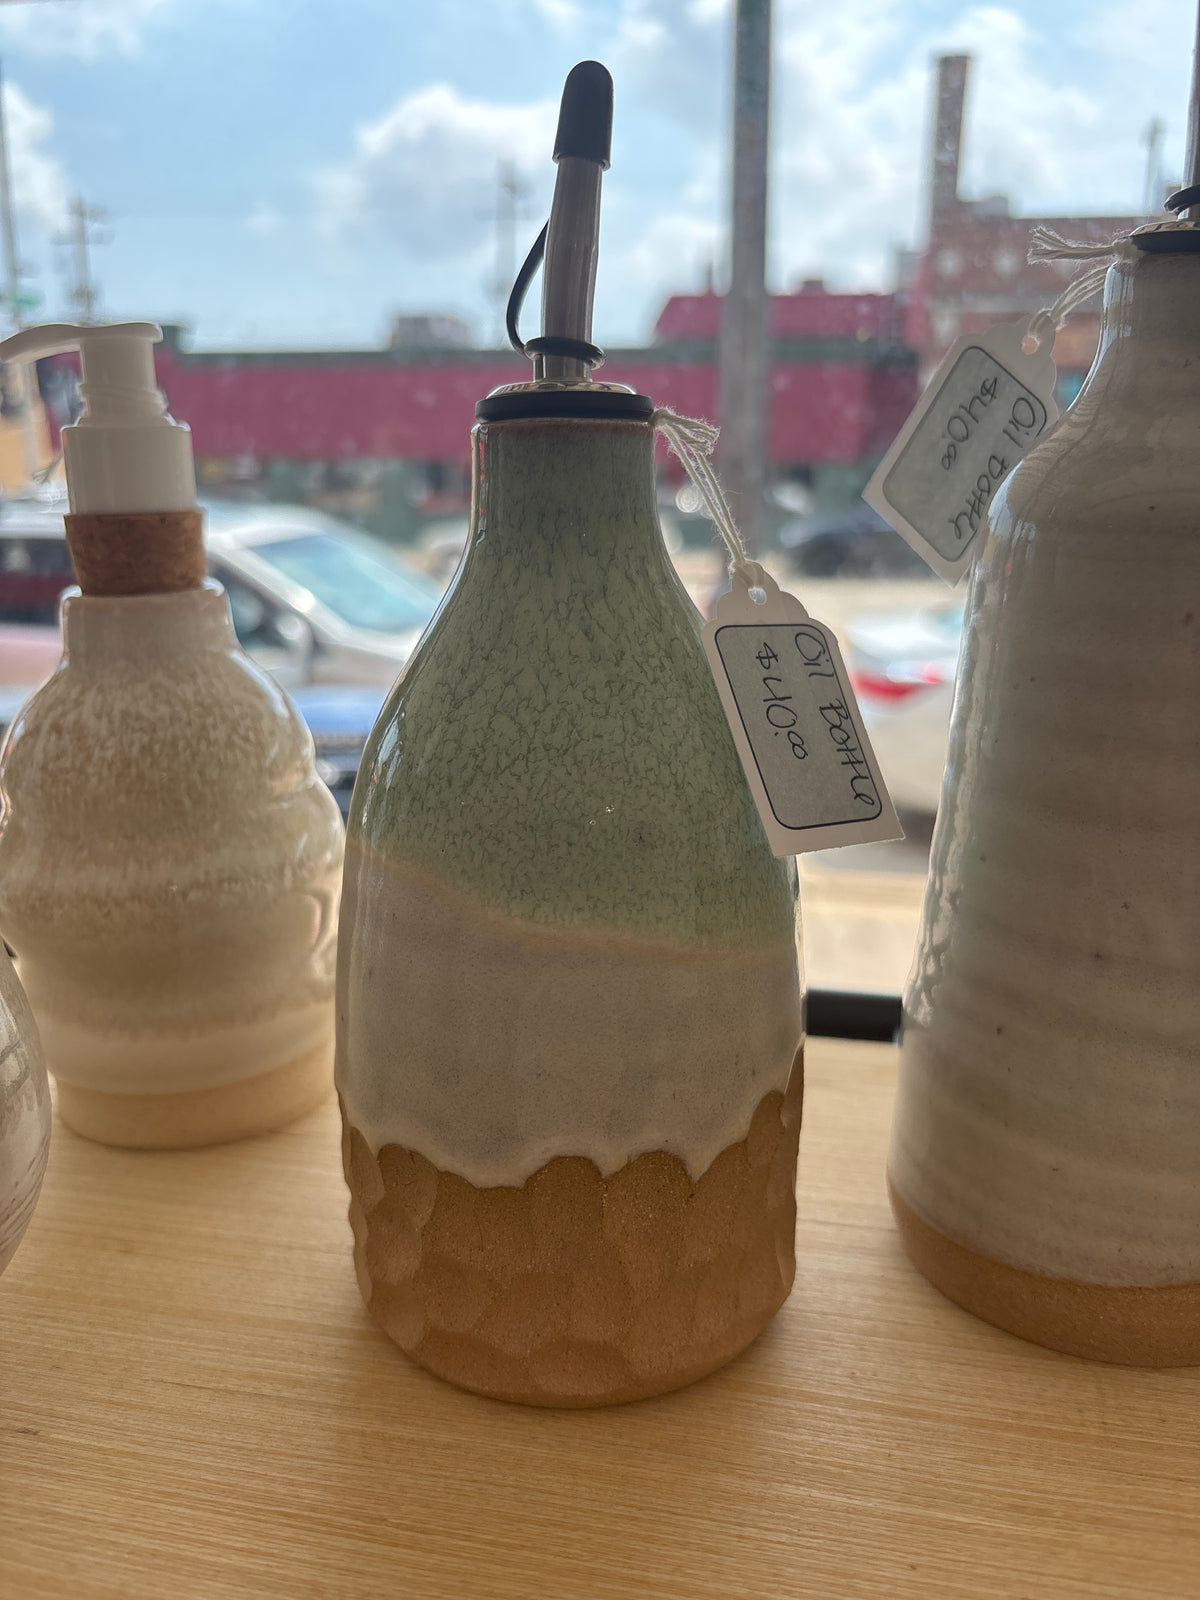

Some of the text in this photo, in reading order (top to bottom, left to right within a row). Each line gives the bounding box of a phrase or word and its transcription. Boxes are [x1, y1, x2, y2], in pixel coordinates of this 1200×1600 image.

[1002, 397, 1036, 448] Oil
[755, 642, 809, 760] $40.00
[794, 632, 875, 806] Oil Bottle
